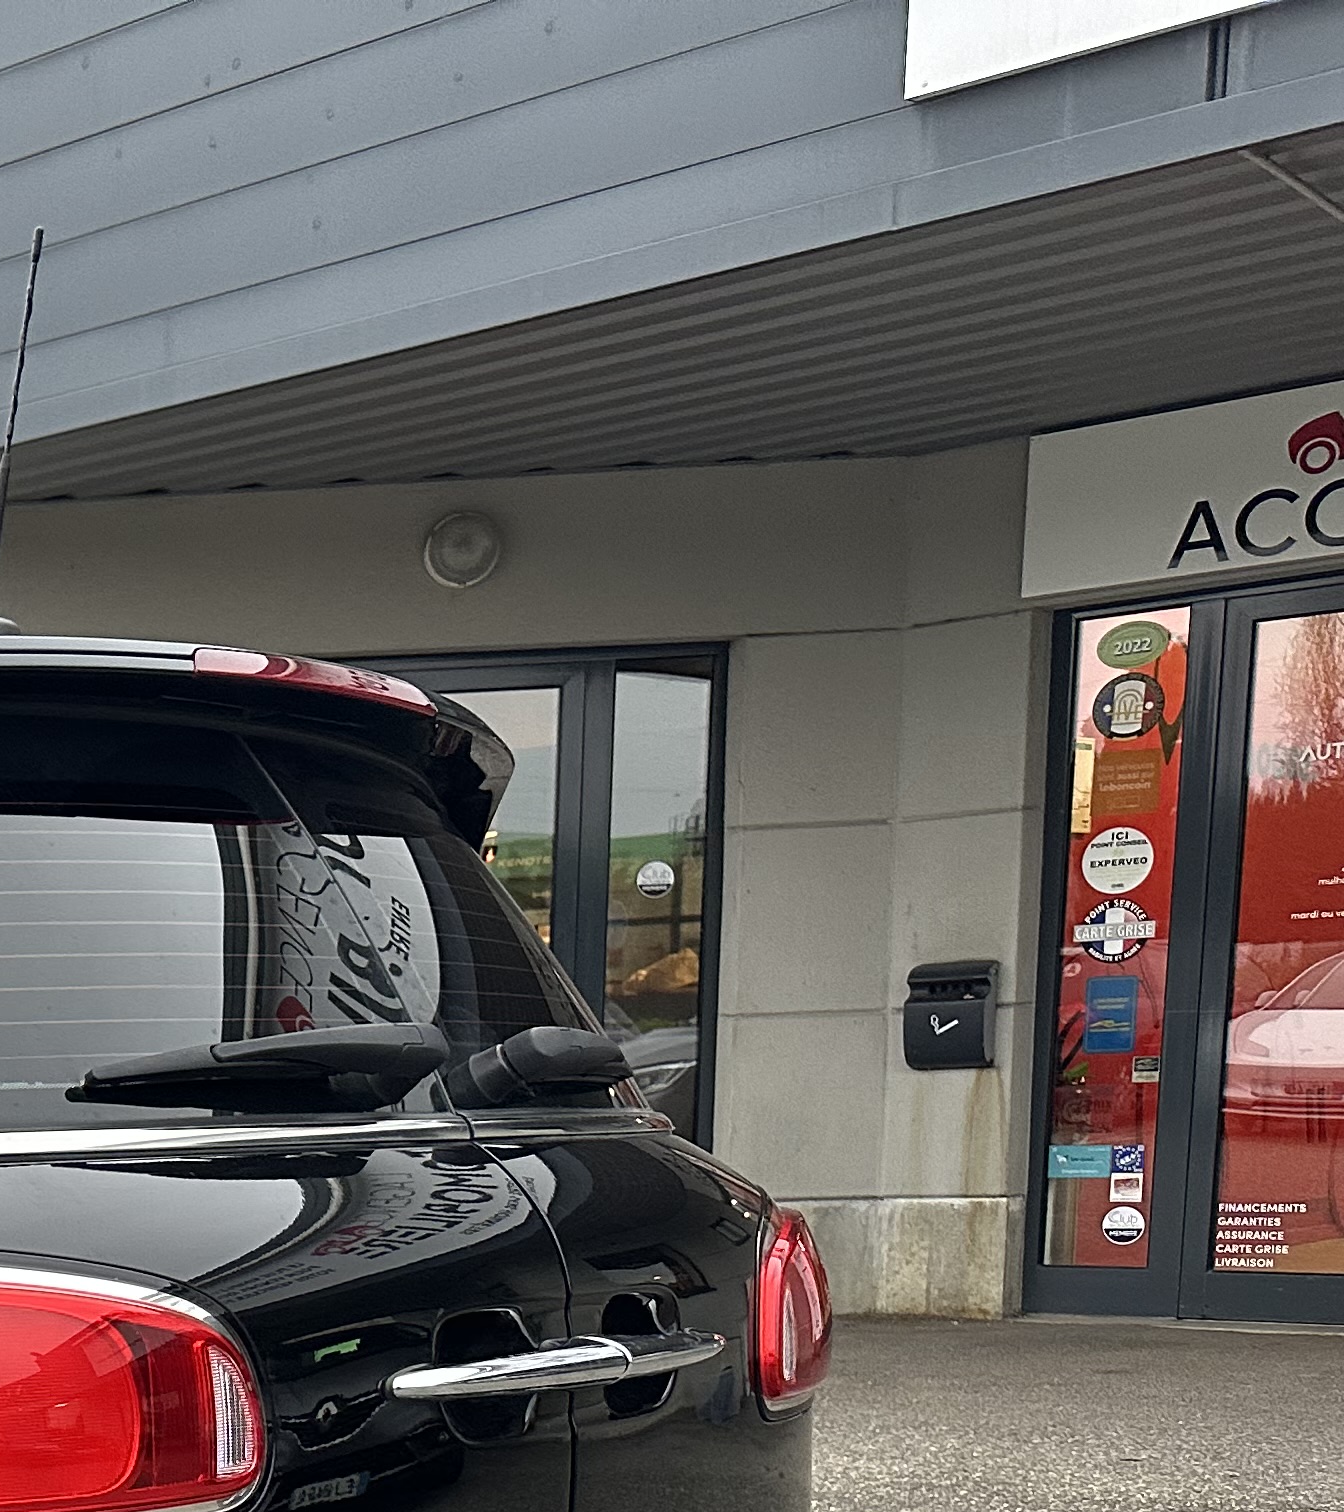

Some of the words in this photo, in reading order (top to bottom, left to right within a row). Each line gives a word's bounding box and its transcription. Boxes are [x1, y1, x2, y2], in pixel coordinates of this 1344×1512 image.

[1114, 637, 1152, 656] 2022
[1111, 831, 1129, 841] ICI
[1084, 900, 1110, 924] POINT
[1113, 899, 1147, 921] SERVICE
[1075, 925, 1113, 939] CARTE
[1117, 923, 1153, 937] GRISE
[1218, 1203, 1307, 1213] FINANCEMENTS
[1217, 1217, 1281, 1226] GARANTIES
[1216, 1230, 1284, 1240] ASSURANCE
[1215, 1244, 1253, 1254] CARTE
[1254, 1244, 1290, 1254] GRISE
[1214, 1257, 1274, 1267] LIVRAISON
